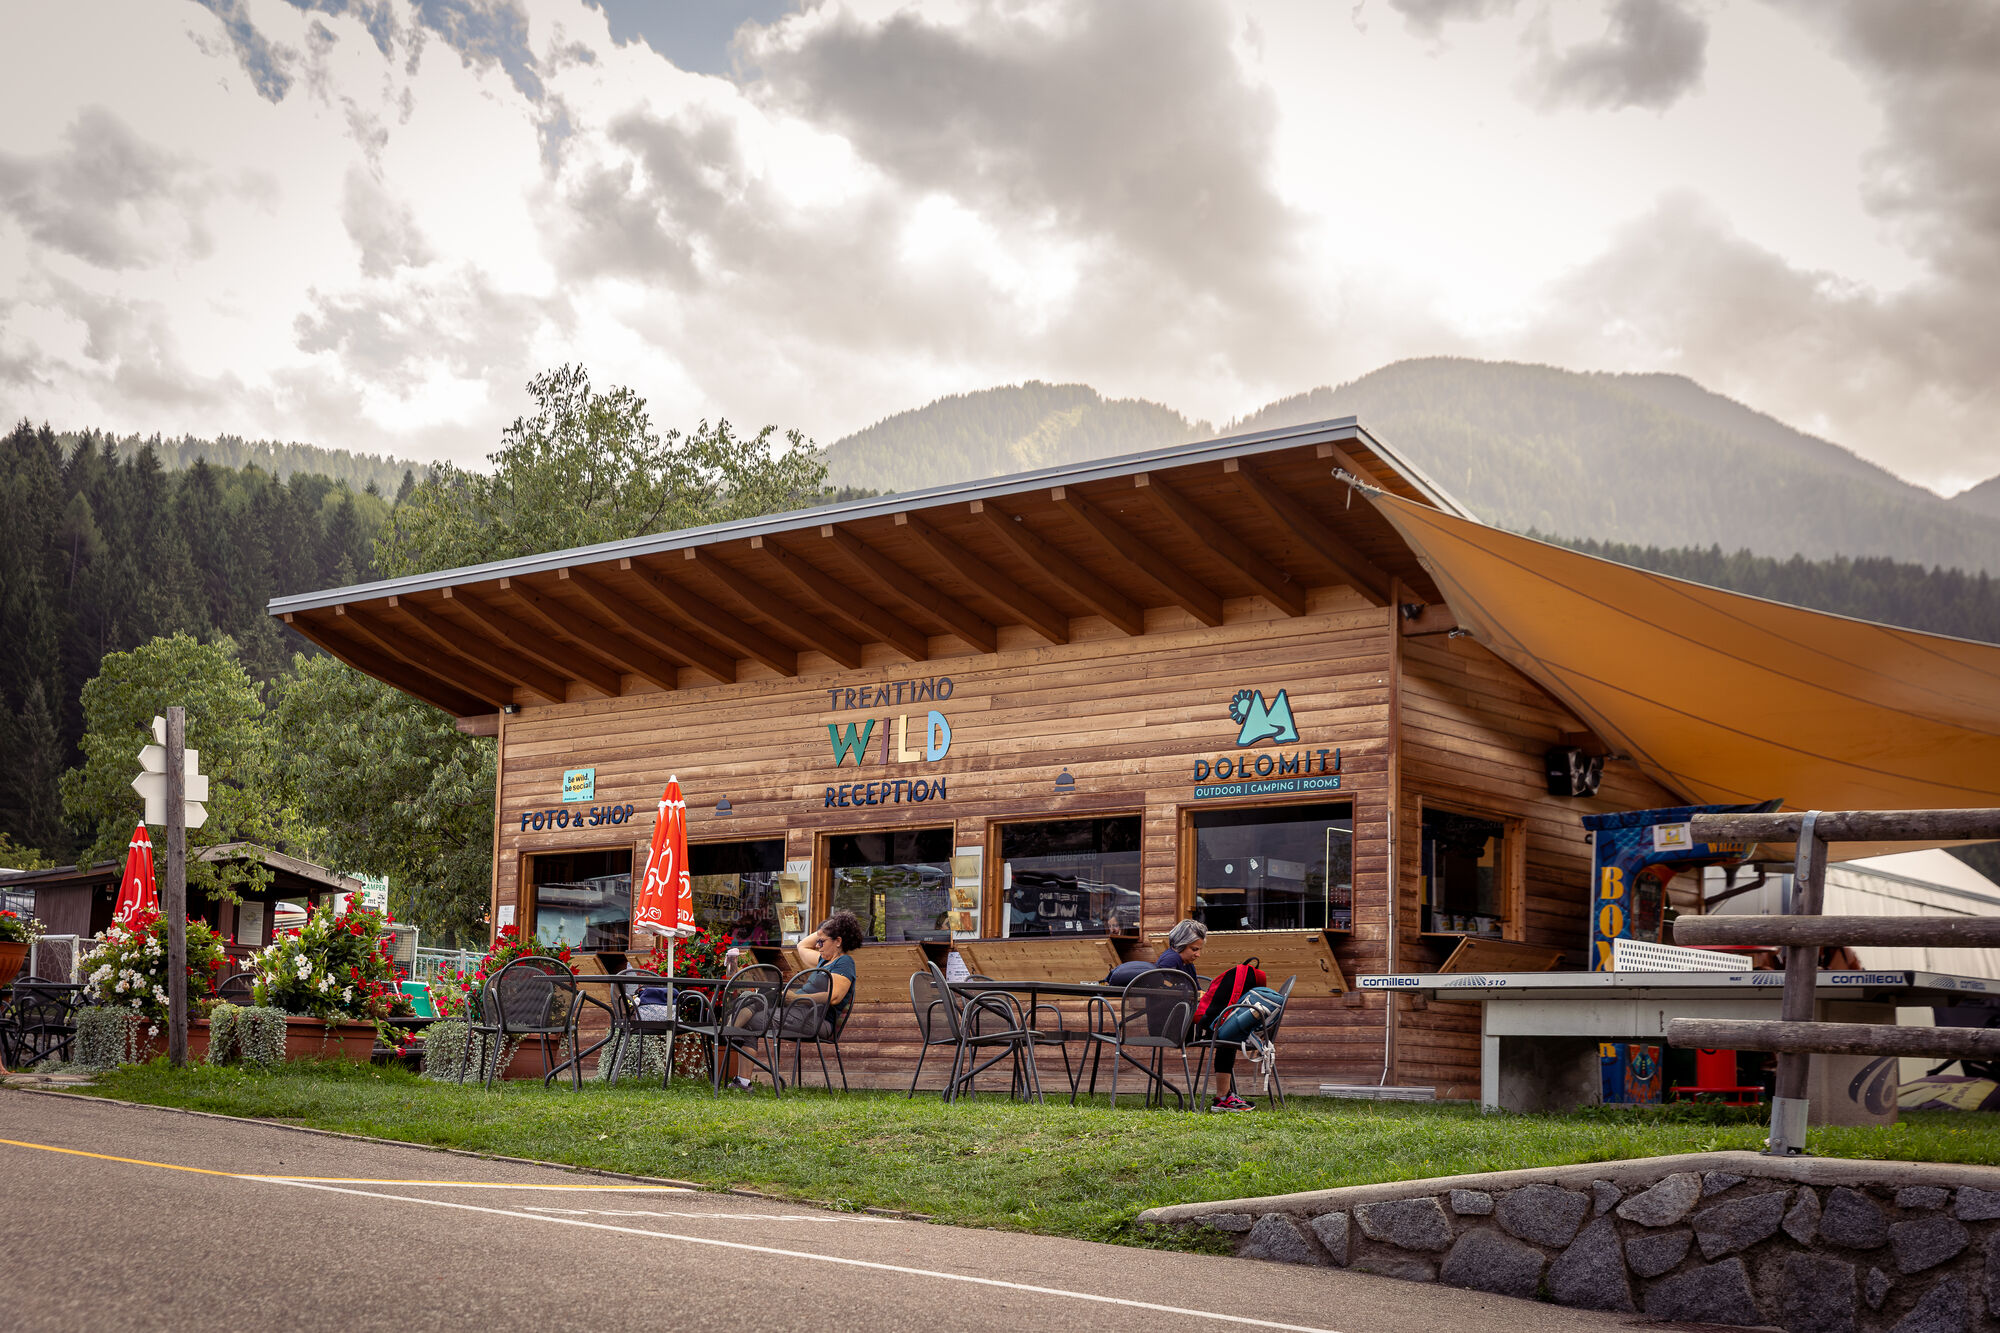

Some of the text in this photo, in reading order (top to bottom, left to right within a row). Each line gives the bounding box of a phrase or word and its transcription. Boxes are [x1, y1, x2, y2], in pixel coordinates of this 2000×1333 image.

[827, 677, 953, 711] TRENTINO
[827, 710, 952, 768] WILD
[1193, 748, 1341, 781] DOLOMITI
[824, 777, 946, 807] RECEPTION
[1196, 777, 1339, 797] OUTDOOR CAMPING ROOMS
[520, 804, 634, 832] FOTO & SHOP
